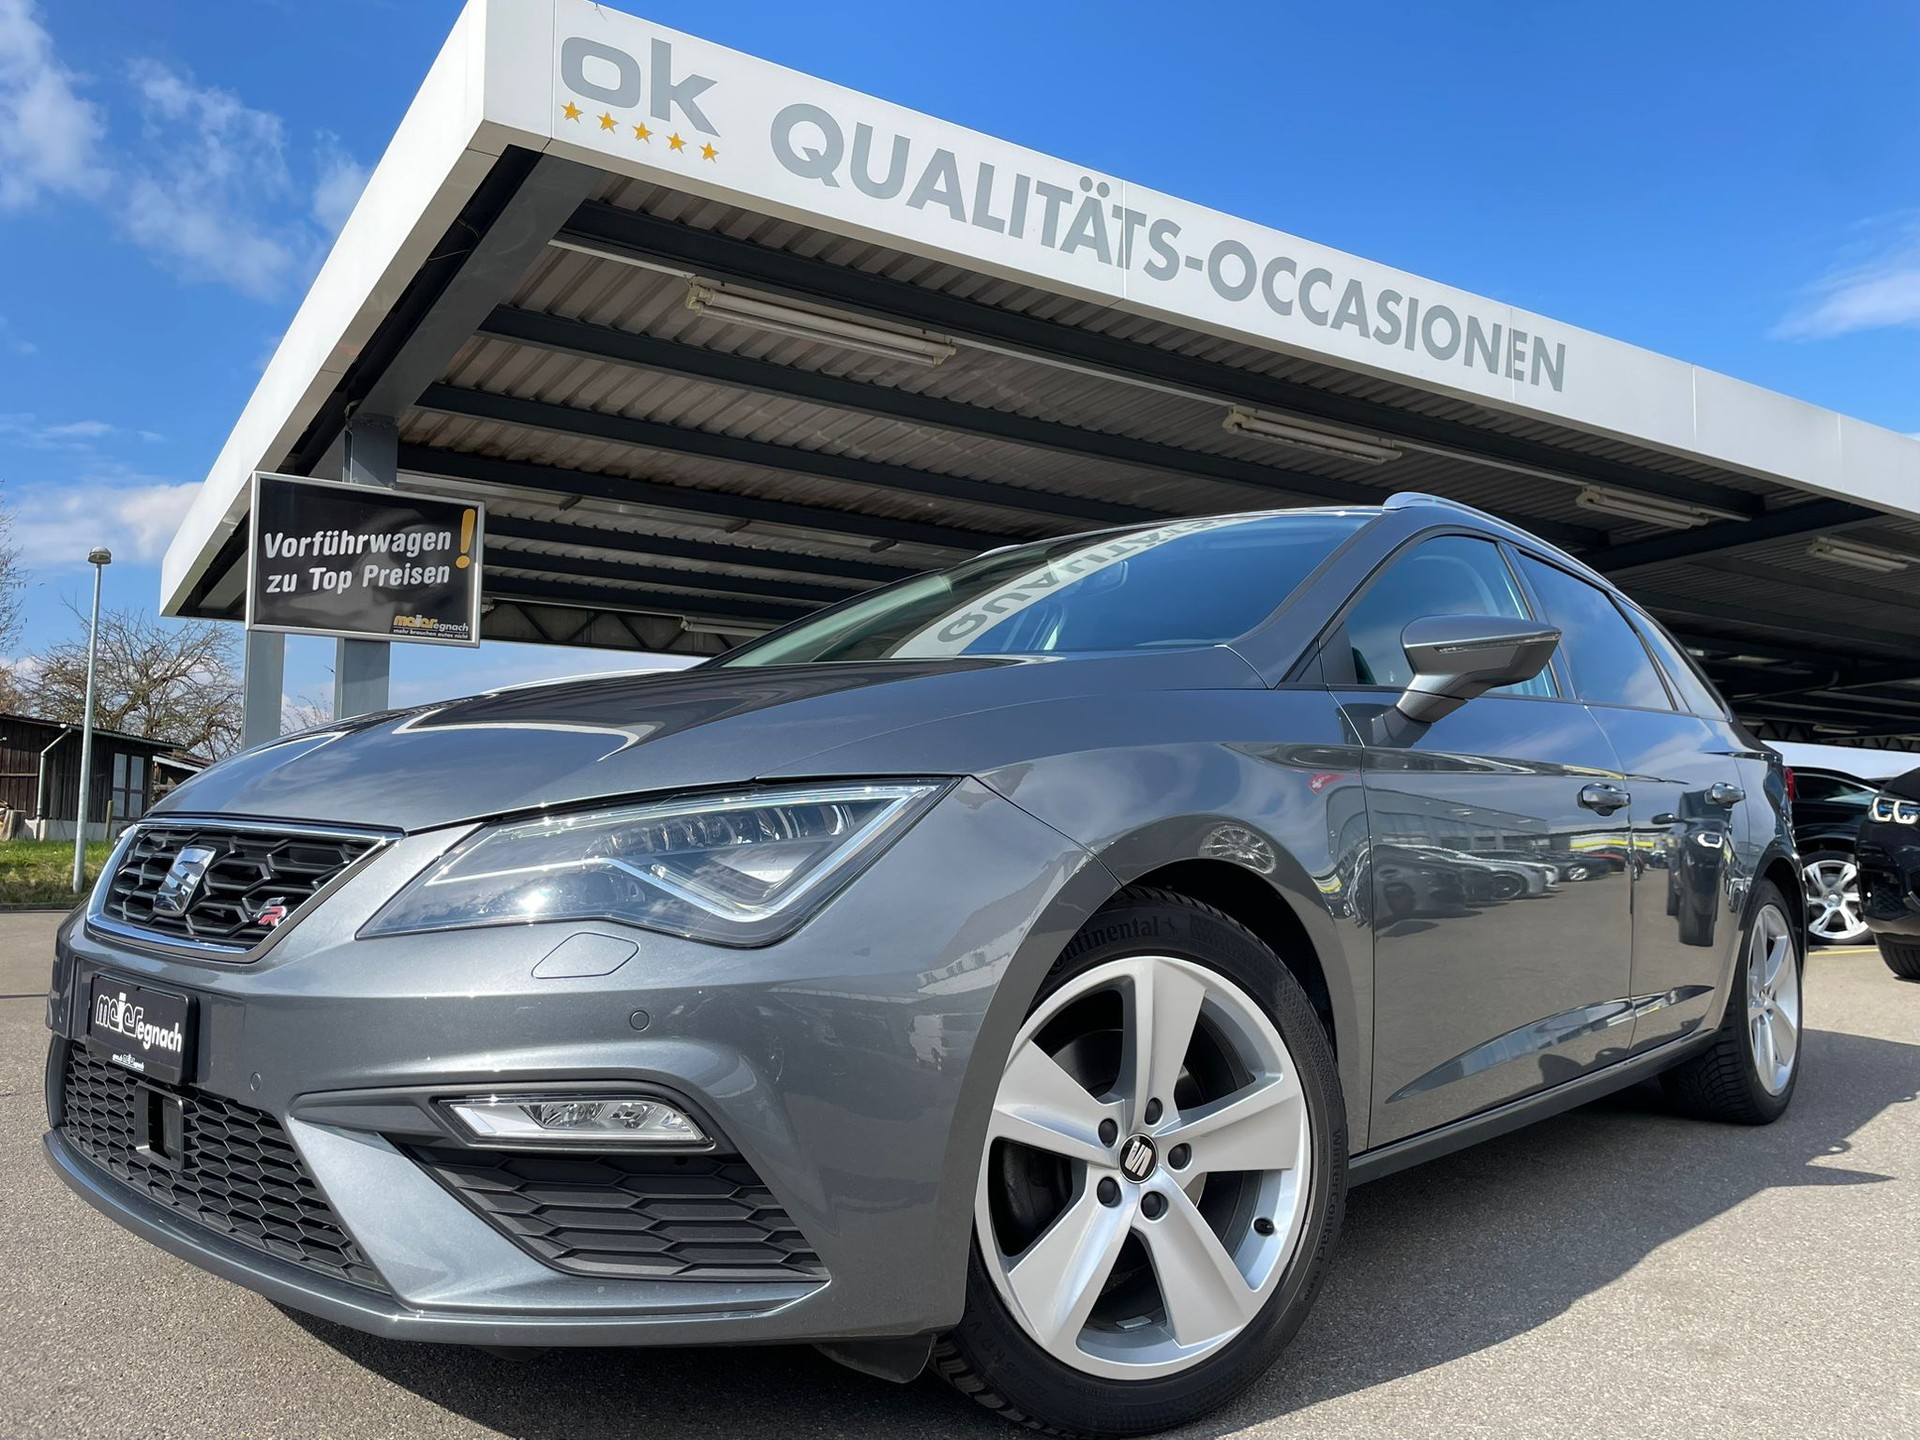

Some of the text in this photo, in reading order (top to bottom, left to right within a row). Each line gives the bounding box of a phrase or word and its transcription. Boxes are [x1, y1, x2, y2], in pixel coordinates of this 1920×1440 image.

[560, 36, 721, 137] ok
[770, 103, 1566, 393] QUALITÄTS-OCCASIONEN
[264, 530, 451, 559] Vorführwagen
[266, 562, 450, 595] zu Top Preisen
